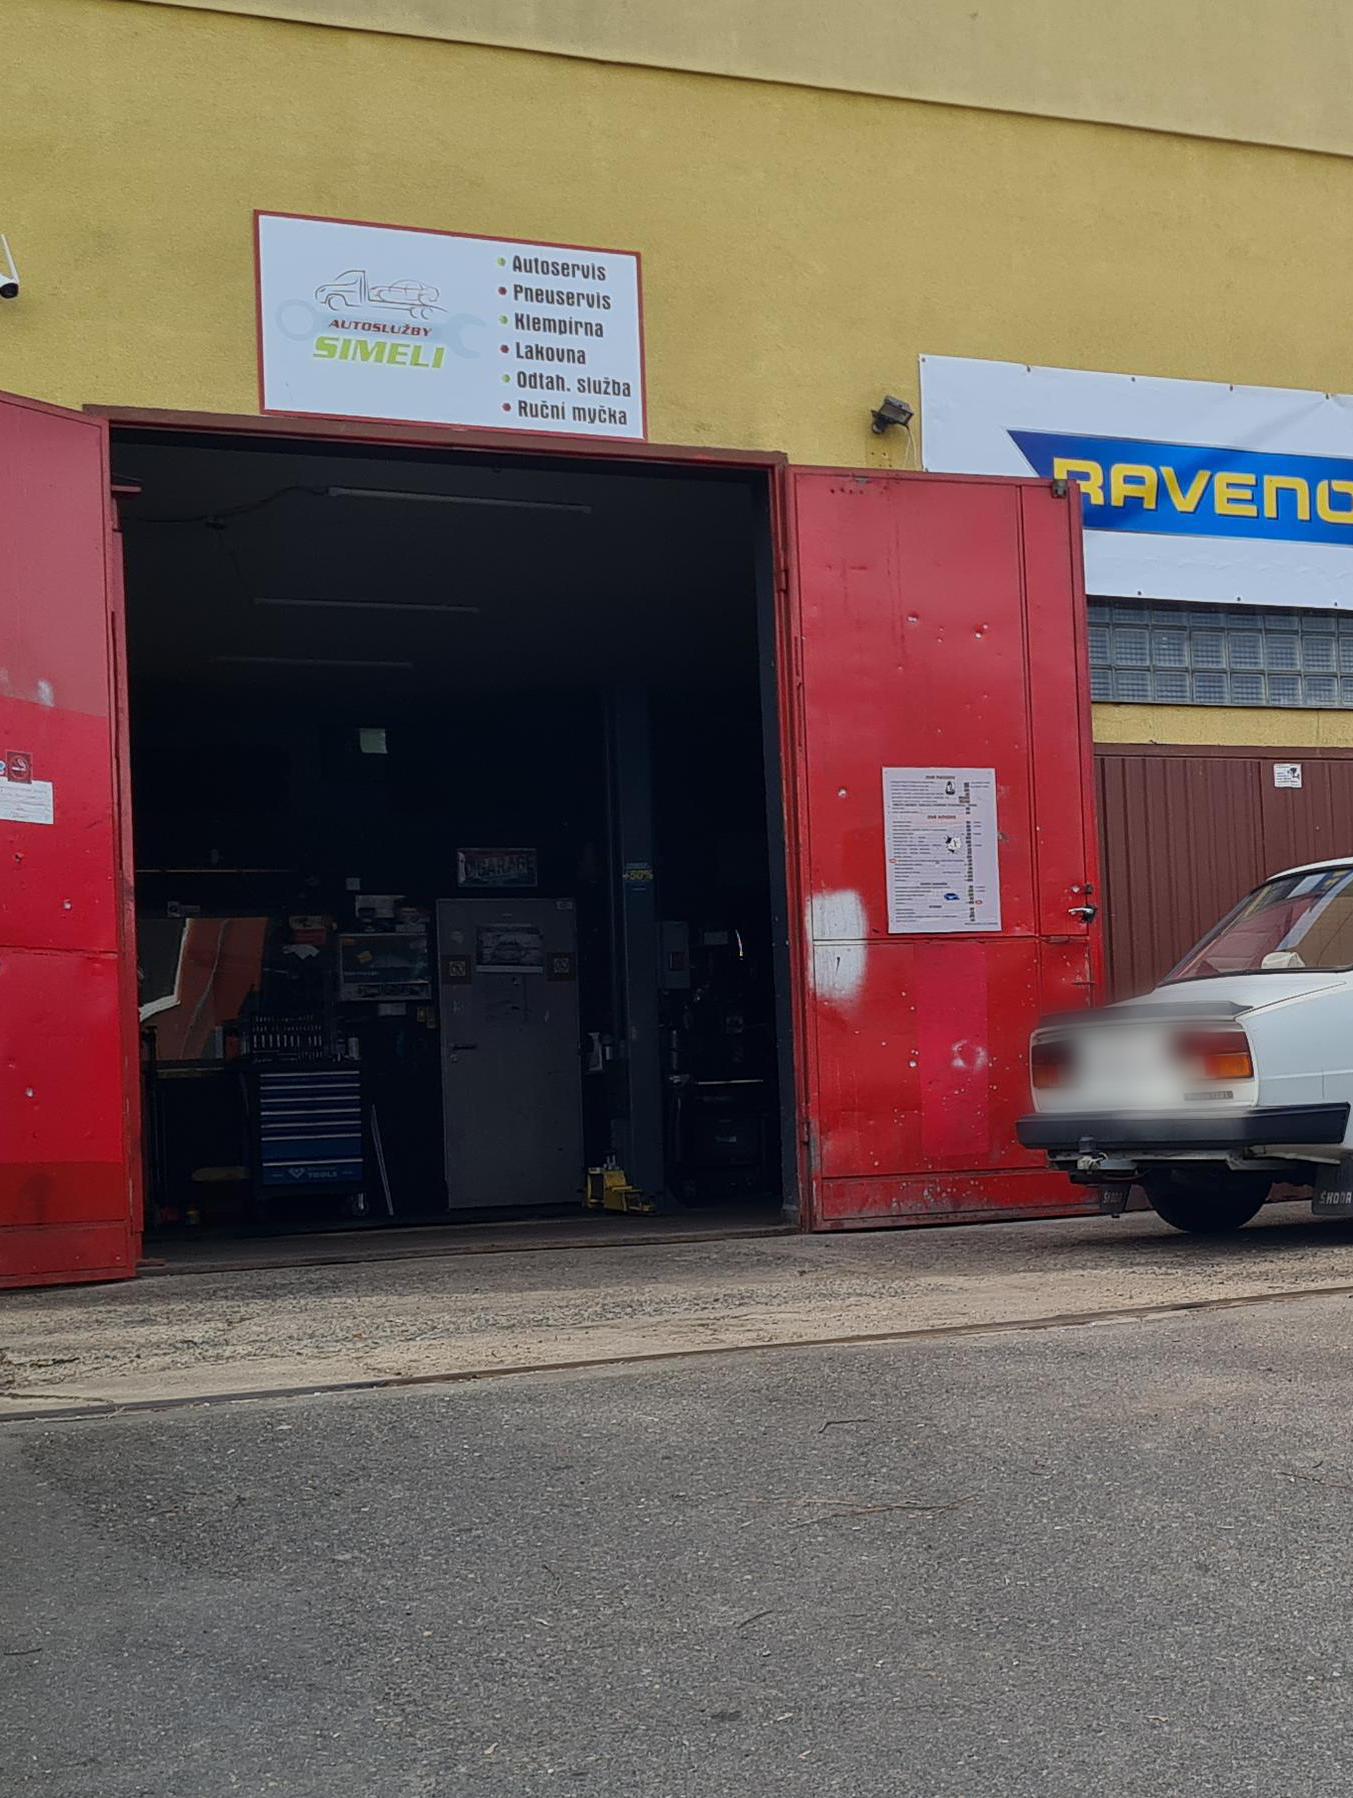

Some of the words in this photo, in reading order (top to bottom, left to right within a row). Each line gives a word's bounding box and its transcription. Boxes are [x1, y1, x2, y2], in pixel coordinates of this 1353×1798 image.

[512, 255, 607, 281] Autoservis
[513, 284, 611, 310] Pneuservis
[329, 319, 432, 336] AUTOSLUŽBY
[313, 335, 445, 369] SIMELI
[515, 342, 586, 365] Lakovna
[516, 370, 571, 392] Odtah.
[577, 377, 631, 397] služba
[518, 400, 566, 420] Ruční
[572, 404, 628, 425] myčka
